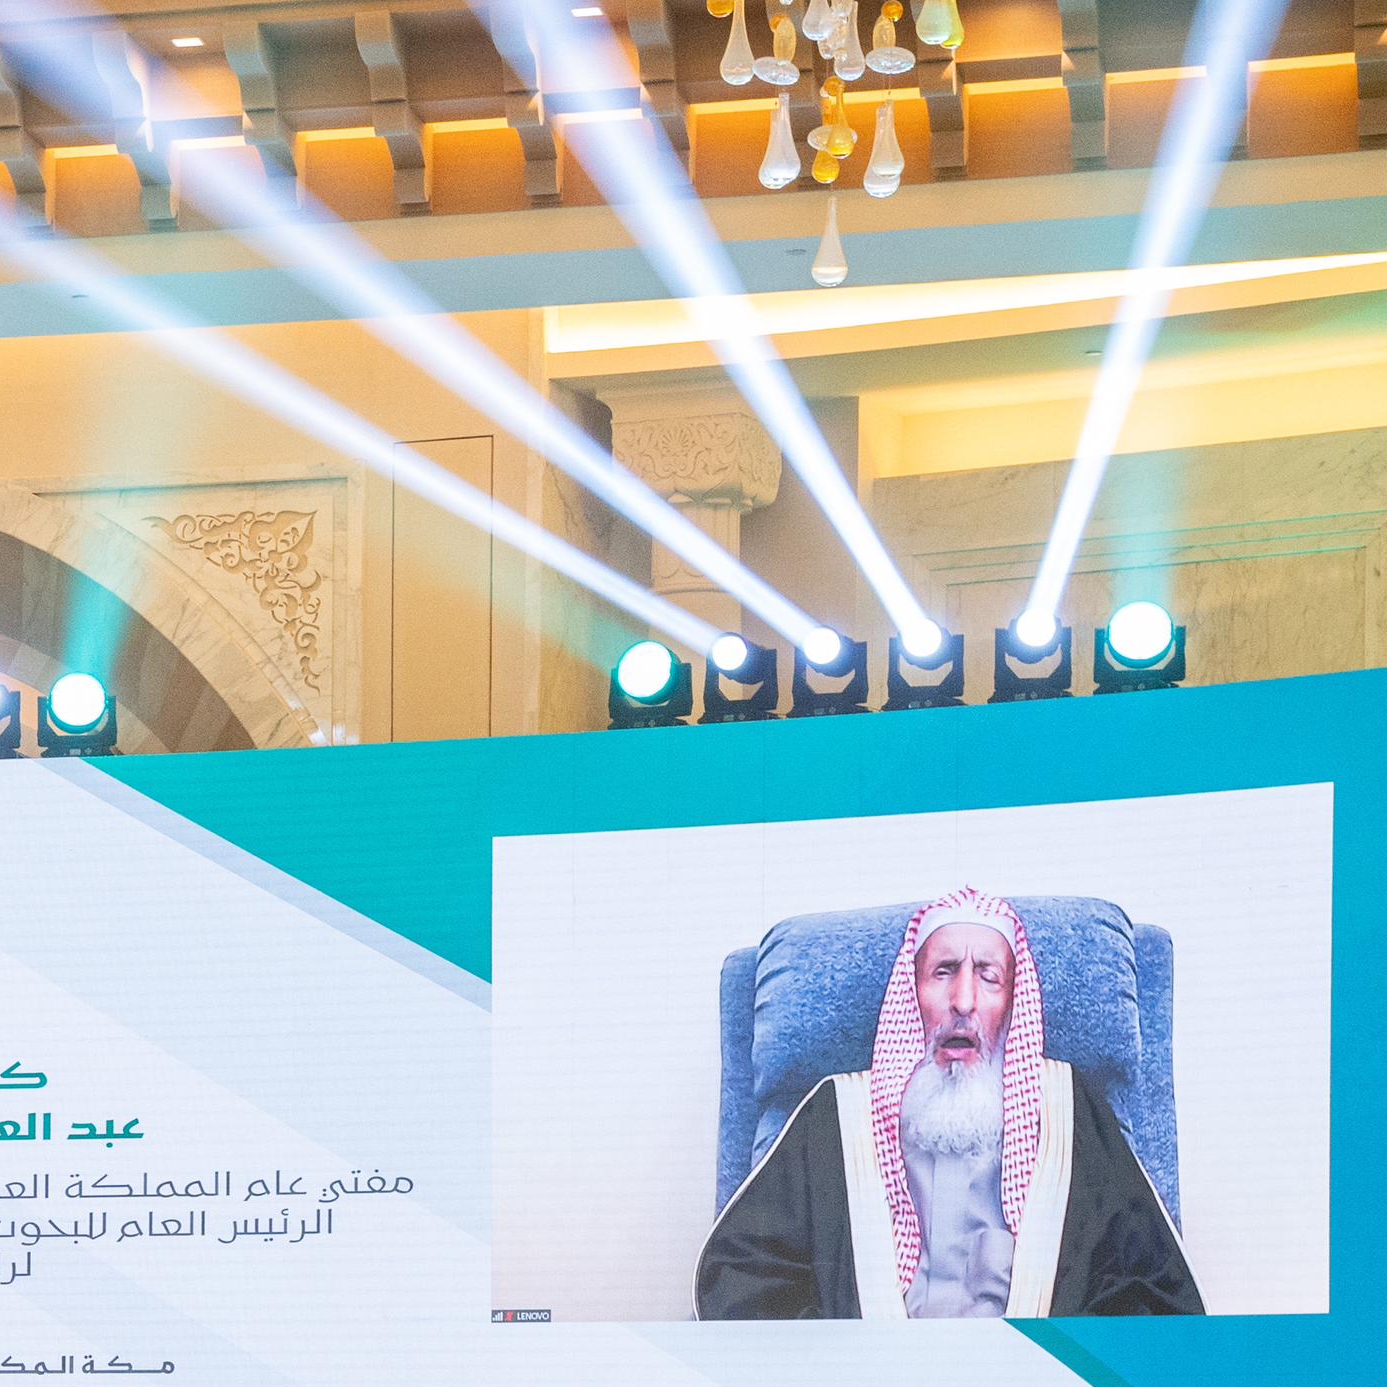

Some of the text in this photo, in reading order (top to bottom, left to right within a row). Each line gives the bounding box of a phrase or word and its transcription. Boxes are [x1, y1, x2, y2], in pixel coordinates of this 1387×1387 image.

[67, 1118, 144, 1149] عبد
[65, 1171, 231, 1199] المملكة
[243, 1169, 307, 1202] عام
[318, 1169, 414, 1203] مفتي
[117, 1210, 206, 1243] العام
[217, 1208, 332, 1244] الرئيس
[516, 1311, 550, 1321] LENOVO
[81, 1354, 175, 1375] مكة
